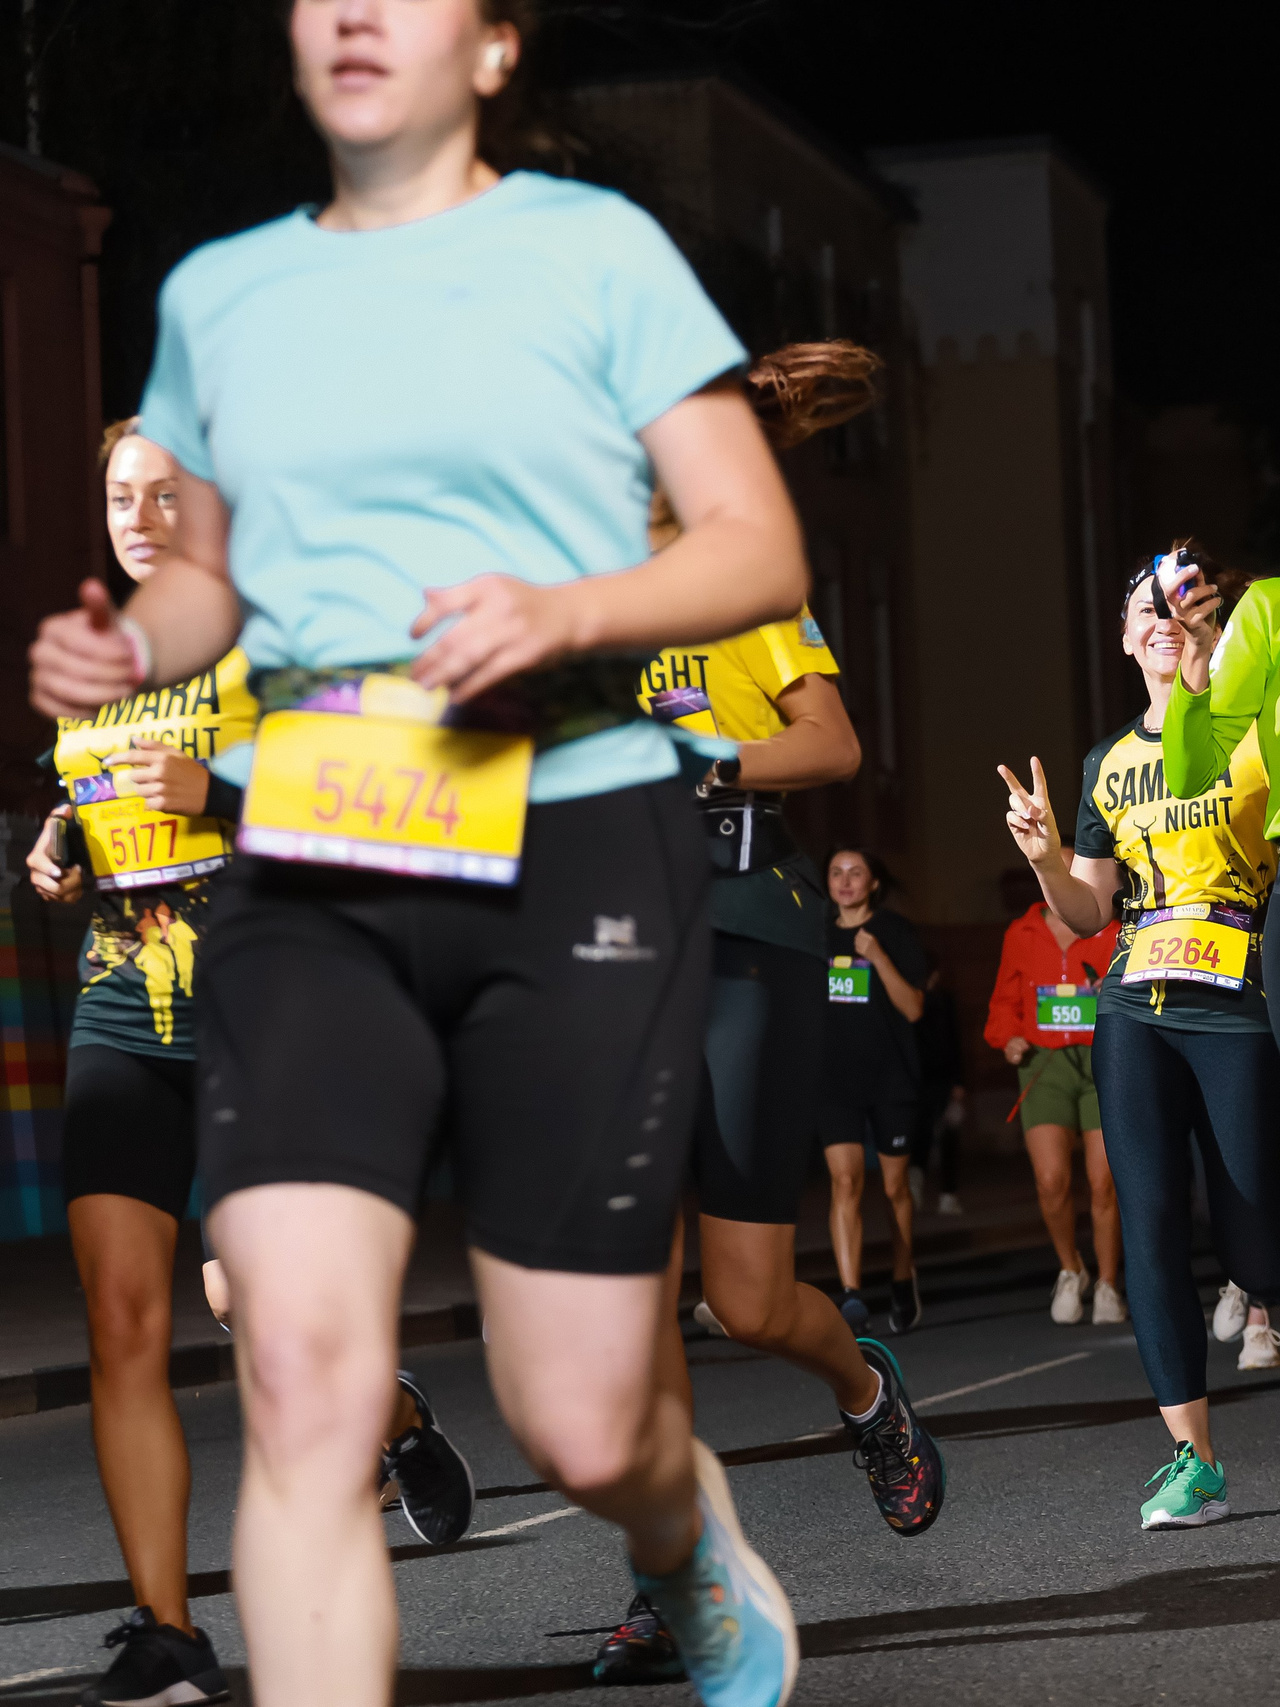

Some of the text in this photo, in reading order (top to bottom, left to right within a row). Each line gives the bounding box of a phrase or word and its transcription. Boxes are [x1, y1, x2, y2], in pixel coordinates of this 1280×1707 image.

[636, 653, 709, 694] GHT
[64, 668, 221, 731] MARA
[312, 760, 461, 837] 5474
[1104, 758, 1233, 813] SAMA
[1165, 796, 1233, 833] NIGHT
[110, 819, 178, 867] 5177
[1147, 937, 1221, 969] 5264
[829, 976, 854, 995] 549
[1051, 1005, 1081, 1023] 550
